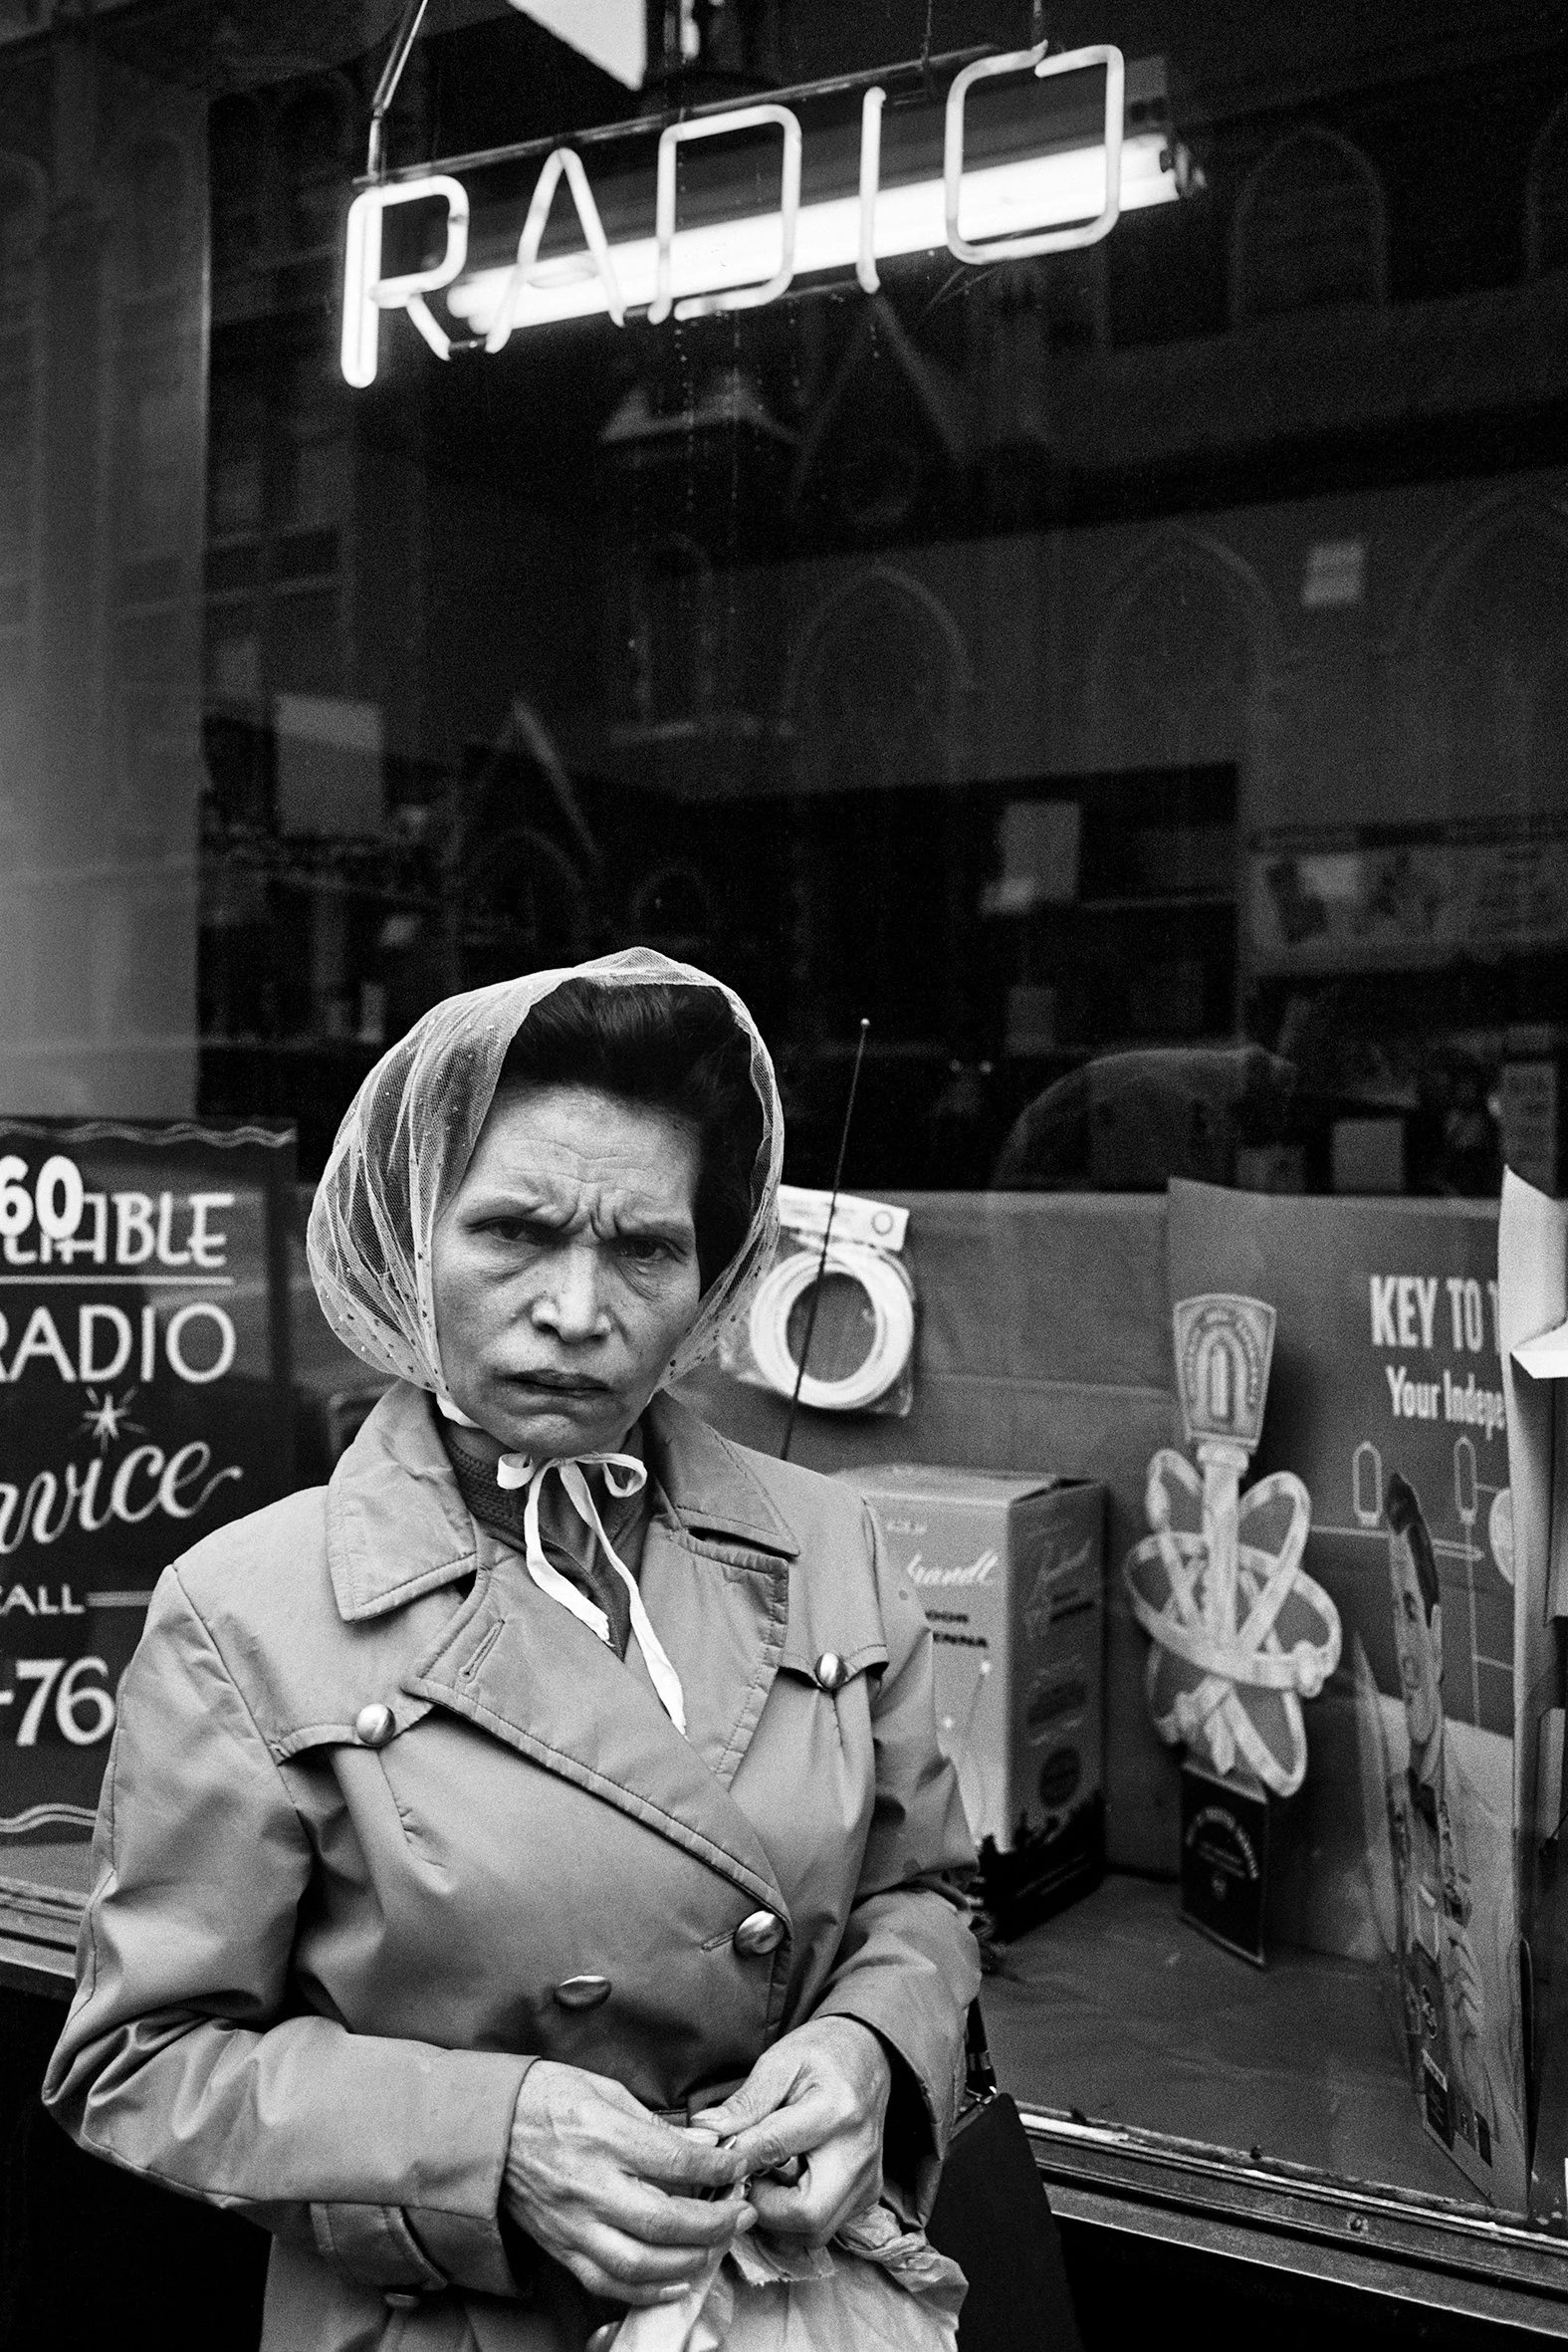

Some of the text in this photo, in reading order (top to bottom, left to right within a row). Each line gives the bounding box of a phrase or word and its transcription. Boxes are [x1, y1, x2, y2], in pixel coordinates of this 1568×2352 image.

[340, 40, 1125, 388] RADIO
[0, 1302, 237, 1383] ADIO
[1370, 1275, 1439, 1349] KEY
[1447, 1278, 1484, 1352] TO
[1386, 1365, 1441, 1420] Your
[0, 1583, 86, 1615] ALL
